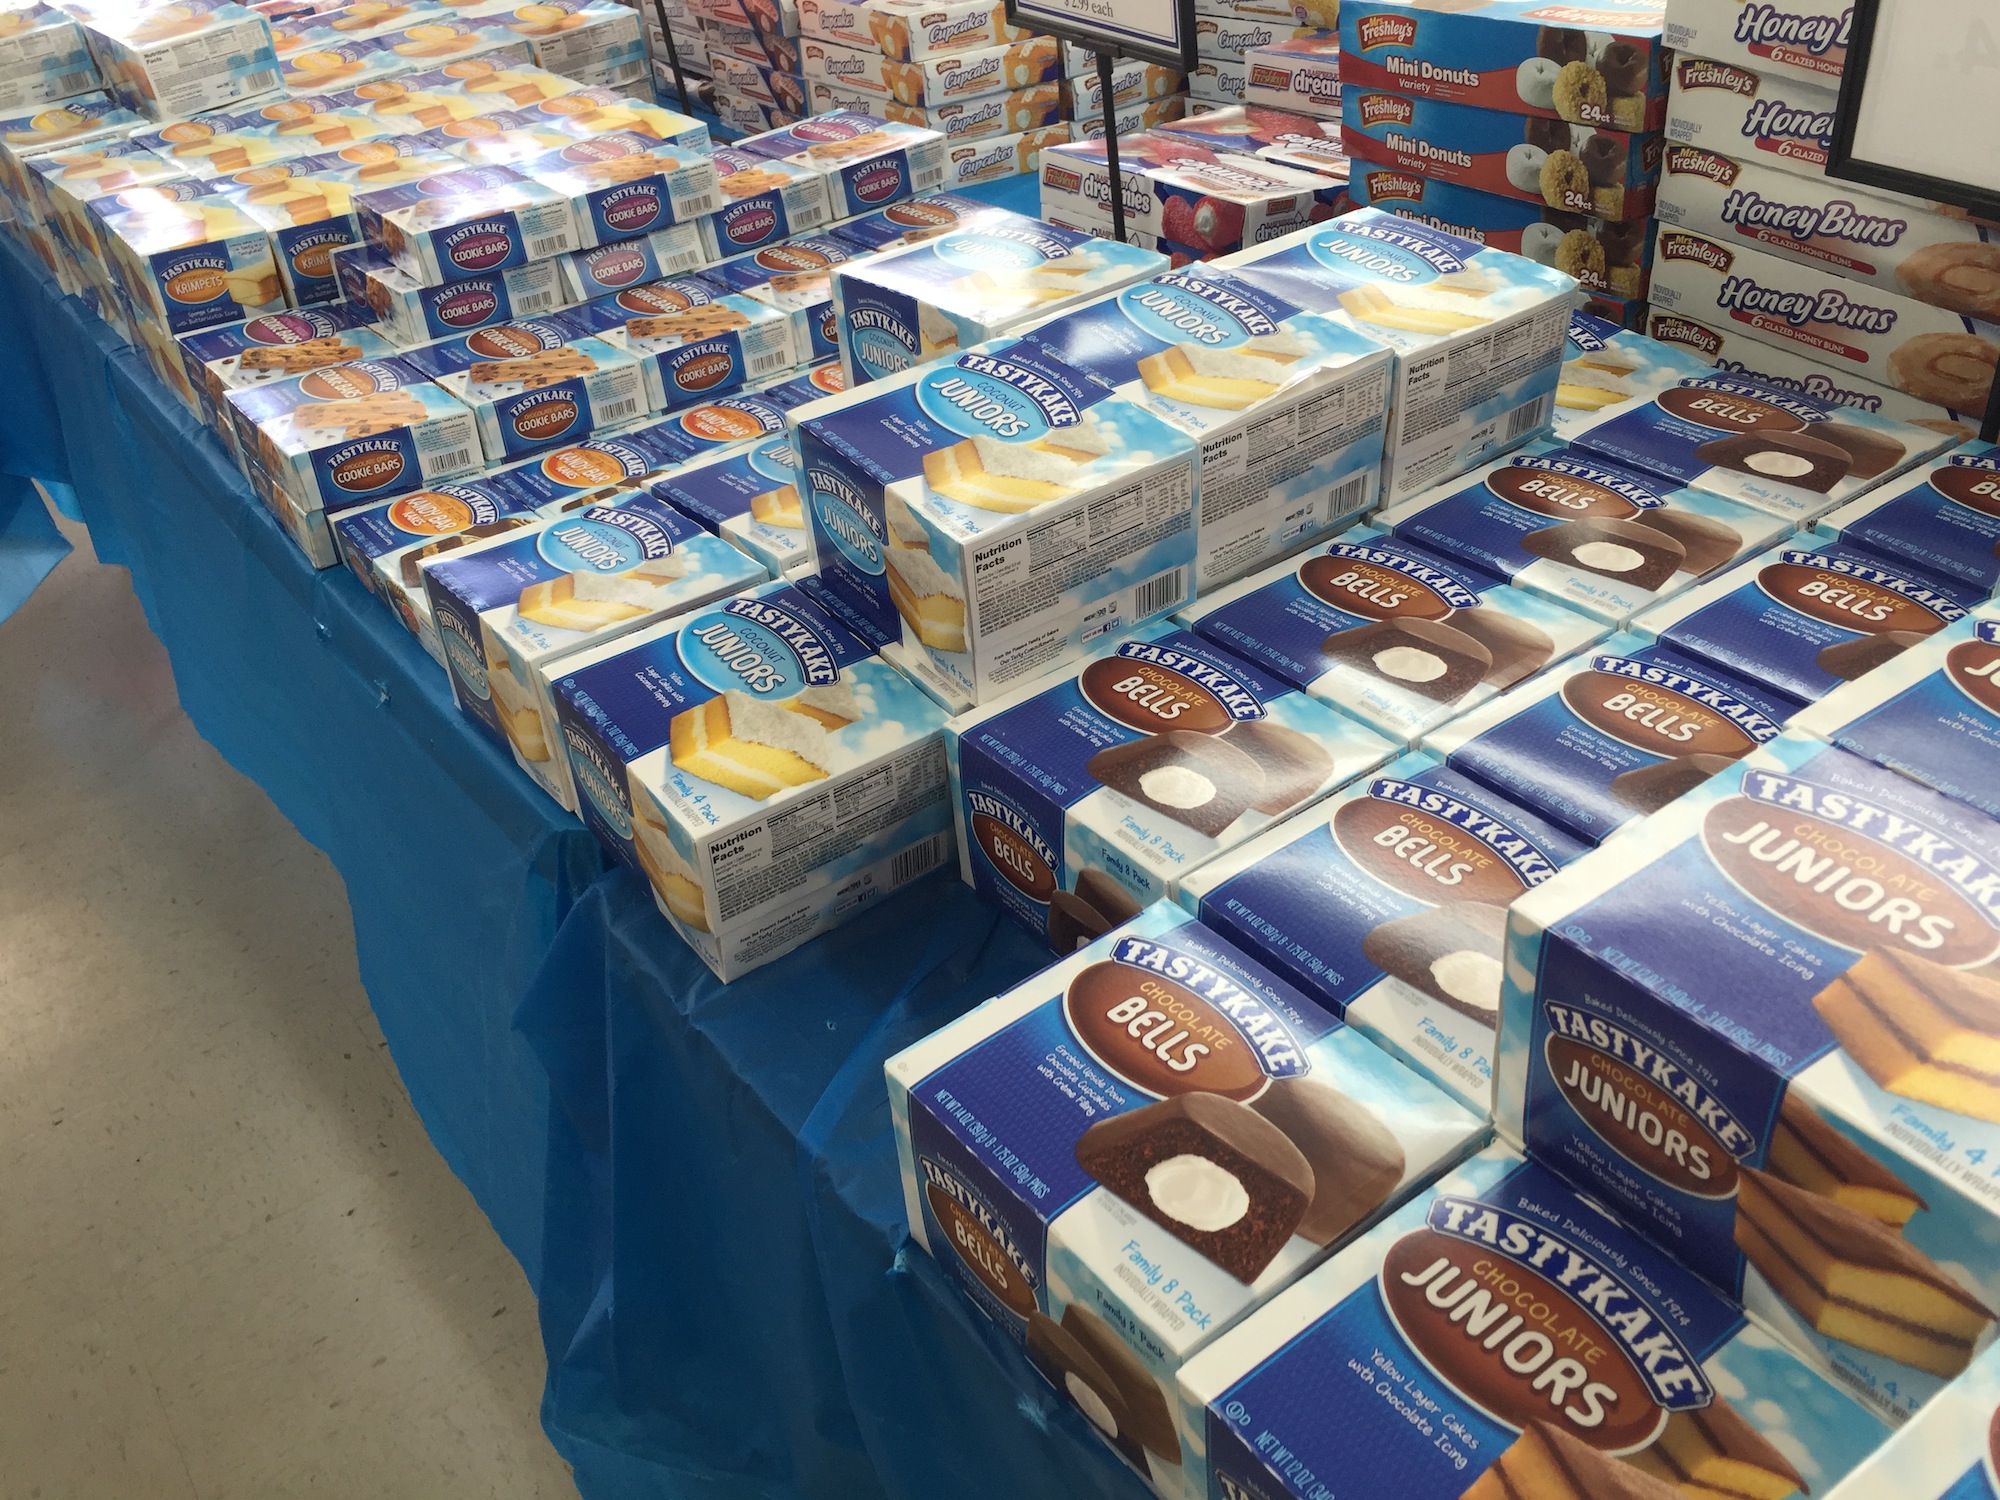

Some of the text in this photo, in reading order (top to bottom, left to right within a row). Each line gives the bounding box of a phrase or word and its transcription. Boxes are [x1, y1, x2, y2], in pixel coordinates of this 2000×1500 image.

[819, 10, 854, 29] Cupcakes
[929, 13, 988, 43] Cupcakes
[1092, 2, 1113, 17] each
[1737, 4, 1844, 53] Honey
[1218, 28, 1271, 49] Cupcakes
[1361, 21, 1413, 44] Freshley's
[824, 56, 864, 75] Cupcakes
[944, 58, 1000, 89] Cupcakes
[1386, 56, 1479, 87] Mini Donuts
[1685, 69, 1752, 95] Freshley's
[1399, 78, 1430, 94] Variety
[946, 103, 1001, 133] Cupcakes
[1363, 98, 1411, 120] Freshley's
[959, 146, 1013, 176] Cupcakes
[1386, 133, 1472, 167] Mini Donuts
[1397, 155, 1426, 170] Variety
[1671, 155, 1732, 183] Freshley's
[852, 160, 898, 183] TASTYKAKE
[858, 174, 899, 197] COOKIE BARS
[1370, 177, 1422, 199] Freshley's
[601, 185, 657, 209] TASTYKAKE
[608, 203, 658, 224] COOKIE BARS
[723, 201, 773, 224] TASTYKAKE
[445, 223, 506, 247] TASTYKAKE
[730, 216, 774, 238] COOKIE BARS
[1724, 192, 1904, 243] Honey Buns
[289, 233, 348, 256] TASTYKAKE
[454, 241, 509, 263] COOKIE BARS
[1318, 238, 1420, 283] JUNIORS
[1344, 220, 1464, 274] TASTYKAKE
[1667, 242, 1727, 269] Freshley's
[1757, 229, 1851, 267] 6 GLAZED HONEY BUNS
[161, 258, 226, 282] TASTYKAKE
[175, 275, 223, 295] KRIMPETS
[433, 282, 493, 305] TASTYKAKE
[441, 299, 495, 320] COOKIE BARS
[1160, 274, 1275, 336] TASTYKAKE
[1721, 279, 1896, 331] Honey Buns
[851, 311, 916, 350] TASTYKAKE
[1130, 289, 1231, 345] JUNIORS
[1751, 315, 1845, 354] 6 GLAZED HONEY BUNS
[671, 343, 730, 370] TASTYKAKE
[1657, 324, 1716, 353] Freshley's
[678, 360, 730, 384] COOKIE BARS
[1408, 355, 1445, 375] Nutrition
[1408, 371, 1430, 386] Facts
[510, 390, 574, 418] TASTYKAKE
[929, 377, 1030, 438] JUNIORS
[964, 355, 1077, 429] TASTYKAKE
[1686, 377, 1825, 422] TASTYKAKE
[1689, 398, 1762, 425] BELLS
[518, 407, 574, 432] COOKIE BARS
[328, 439, 400, 467] TASTYKAKE
[1202, 432, 1243, 454] Nutrition
[1202, 449, 1228, 466] Facts
[337, 458, 401, 484] COOKIE BARS
[1515, 455, 1659, 510] TASTYKAKE
[1536, 472, 1611, 500] CHOCOLATE
[810, 471, 883, 539] TASTYKAKE
[1518, 479, 1597, 510] BELLS
[554, 526, 628, 570] JUNIORS
[591, 508, 674, 560] TASTYKAKE
[823, 510, 879, 563] JUNIORS
[975, 538, 1022, 562] Nutrition
[975, 553, 1006, 575] Facts
[1336, 544, 1477, 609] TASTYKAKE
[1329, 572, 1409, 609] BELLS
[693, 622, 788, 694] JUNIORS
[733, 600, 837, 686] TASTYKAKE
[739, 626, 786, 664] COCONUT
[1111, 676, 1192, 720] BELLS
[1125, 642, 1260, 721] TASTYKAKE
[1601, 656, 1781, 746] TASTYKAKE
[1601, 692, 1702, 742] BELLS
[670, 772, 720, 825] Family 4 Pack
[710, 825, 762, 854] Nutrition
[969, 791, 1057, 870] TASTYKAKE
[1120, 815, 1185, 863] Family 8 Pack
[1399, 812, 1494, 870] CHOCOLATE
[713, 845, 744, 864] Facts
[994, 833, 1035, 883] BELLS
[1372, 824, 1474, 886] BELLS
[1792, 823, 1940, 902] CHOCOLATE
[1722, 821, 1955, 949] JUNIORS
[1682, 899, 1814, 980] with Chocolate Icing
[1704, 892, 1823, 966] Yellow Layer Cakes
[1185, 940, 1304, 1024] Baked Deliciously Since 1914
[1116, 939, 1299, 1075] TASTYKAKE
[1139, 981, 1233, 1050] CHOCOLATE
[1106, 996, 1210, 1072] BELLS
[1046, 1053, 1111, 1111] Chocolate Cupcakes
[1055, 1044, 1125, 1105] Enrobed Upside Down
[1551, 1007, 1747, 1149] TASTYKAKE
[1591, 1054, 1689, 1127] CHOCOLATE
[1564, 1060, 1711, 1179] JUNIORS
[1572, 1134, 1681, 1220] Yellow Layer Cakes
[922, 1159, 1036, 1287] TASTYKAKE
[954, 1219, 1008, 1289] BELLS
[1121, 1239, 1212, 1331] Family 8 Pack
[1444, 1200, 1700, 1406] TASTYKAKE
[1472, 1259, 1607, 1365] CHOCOLATE
[1400, 1257, 1618, 1428] JUNIORS
[1348, 1358, 1468, 1470] with Chocolate Icing
[1371, 1348, 1479, 1450] Yellow Layer Cakes
[1254, 1429, 1316, 1490] NET WT 12 OZ
